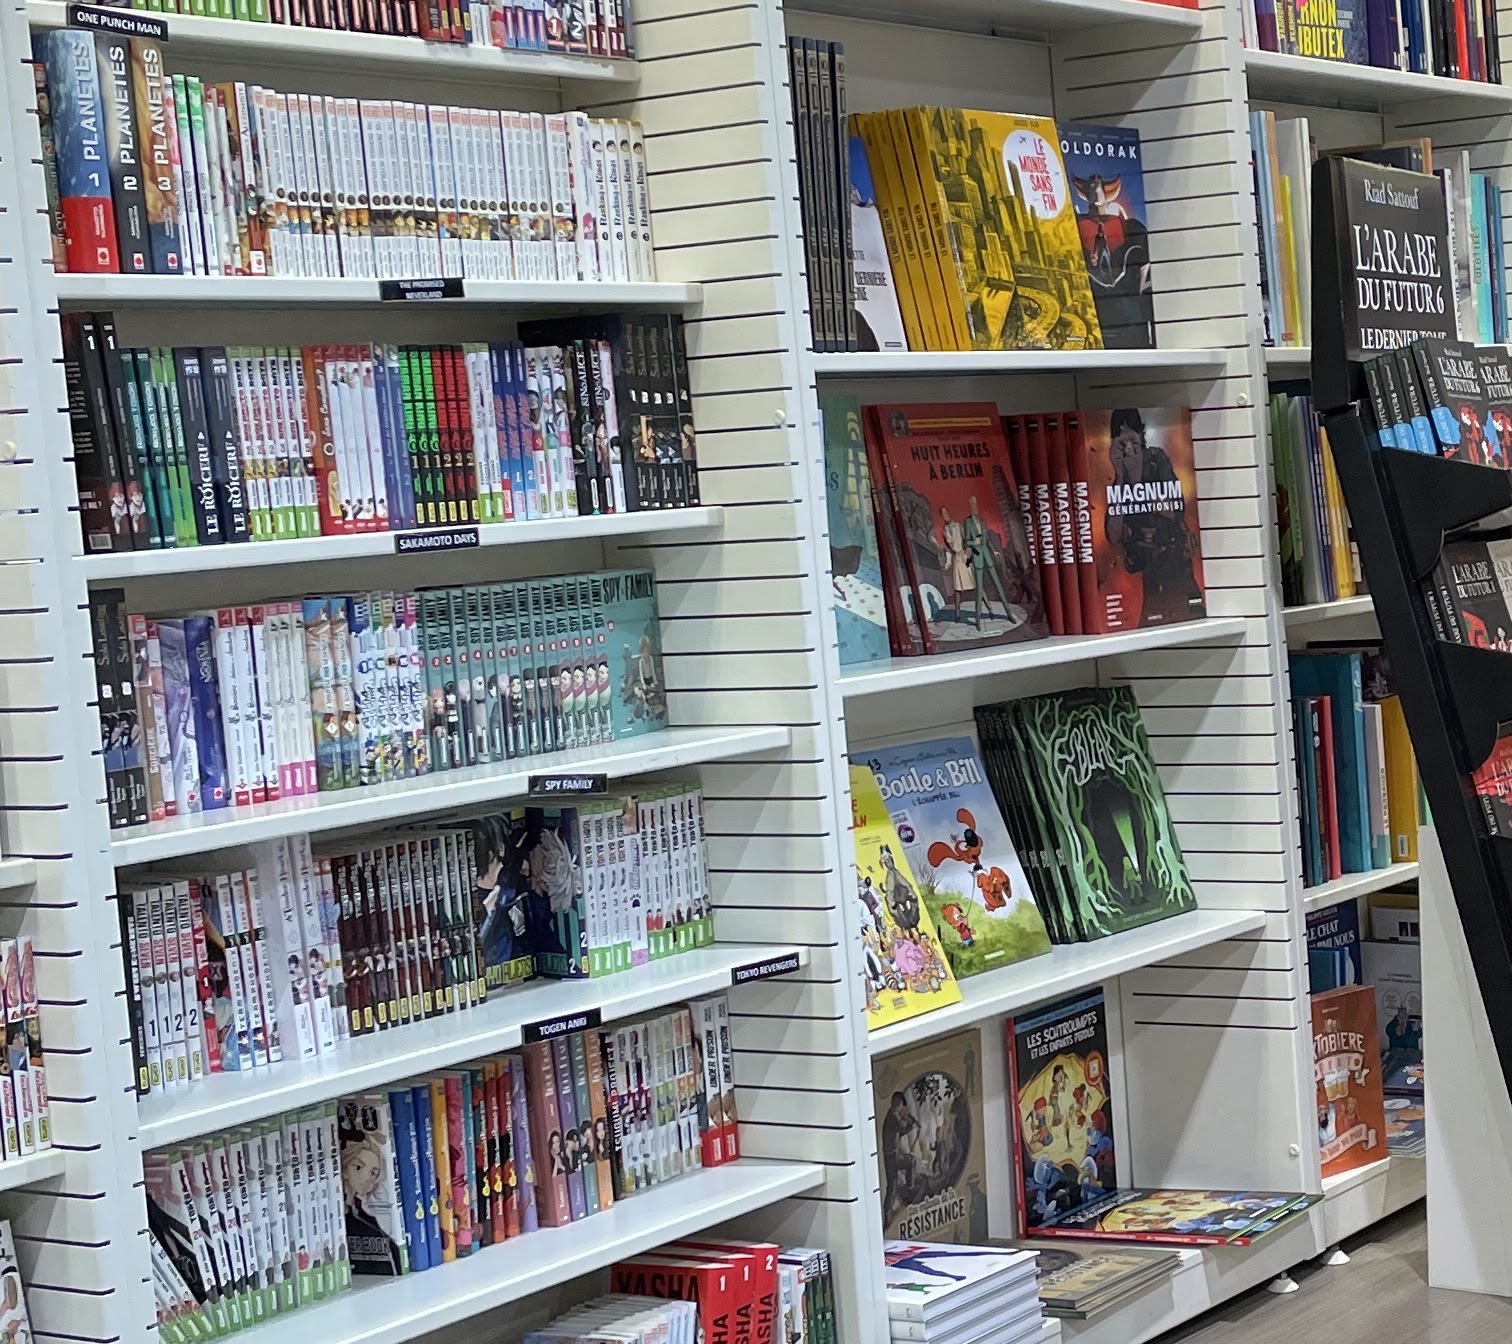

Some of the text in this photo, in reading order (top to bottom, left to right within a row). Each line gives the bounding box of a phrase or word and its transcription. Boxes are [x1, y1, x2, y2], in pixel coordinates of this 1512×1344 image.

[77, 11, 161, 35] ONE PUNCH MAN
[1034, 137, 1045, 157] LE
[1060, 140, 1137, 160] OLDORAK
[1018, 155, 1050, 176] MONDE
[1031, 173, 1053, 192] SANS
[1043, 193, 1058, 212] FIN
[1363, 178, 1419, 210] Riad Sattouf
[1353, 224, 1441, 278] L'ARABE
[1356, 276, 1445, 314] DU FUTUR 6
[1360, 327, 1374, 349] LE
[910, 440, 991, 462] HUIT HEURES
[940, 460, 984, 481] BERLIN
[1106, 480, 1182, 504] MAGNUM
[1034, 482, 1056, 565] MAGNUM
[1054, 481, 1075, 565] MAGNUM
[1072, 480, 1094, 563] MAGNUM
[399, 531, 477, 553] SAKAMOTO DAYS
[545, 778, 594, 791] SPY FAMILY
[873, 765, 935, 803] Boule
[935, 771, 947, 789] &
[944, 757, 983, 788] Bill
[1317, 920, 1339, 939] CHAT
[737, 958, 797, 980] TOKYO REVENGERS
[539, 1017, 587, 1036] TOGEN ANKI
[1026, 1033, 1042, 1049] LES
[899, 1198, 966, 1240] RÉSISTANCE
[743, 1265, 749, 1281] 1
[765, 1255, 773, 1271] 2
[720, 1275, 726, 1291] 1
